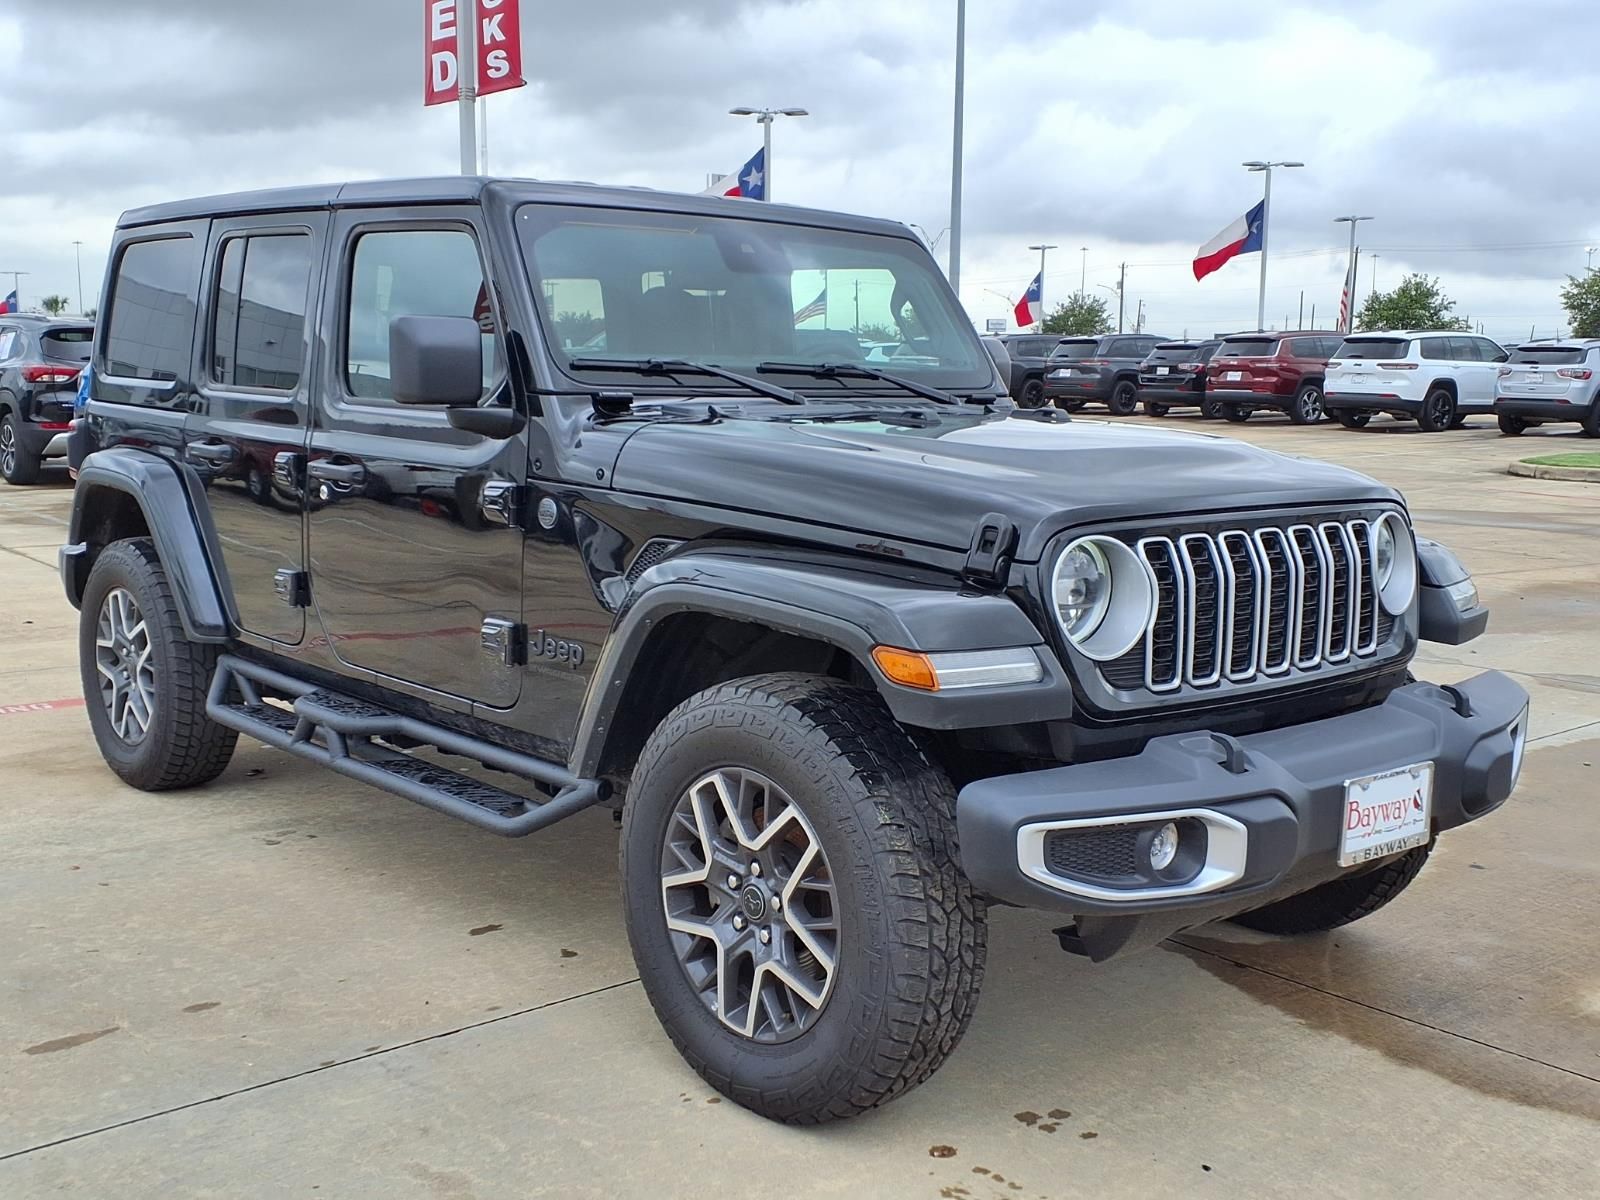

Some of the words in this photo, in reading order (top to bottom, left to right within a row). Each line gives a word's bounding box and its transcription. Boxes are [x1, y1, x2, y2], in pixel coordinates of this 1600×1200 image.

[529, 629, 584, 670] Jeep
[1347, 798, 1411, 835] Bayway
[1364, 838, 1408, 860] BAYWAY
